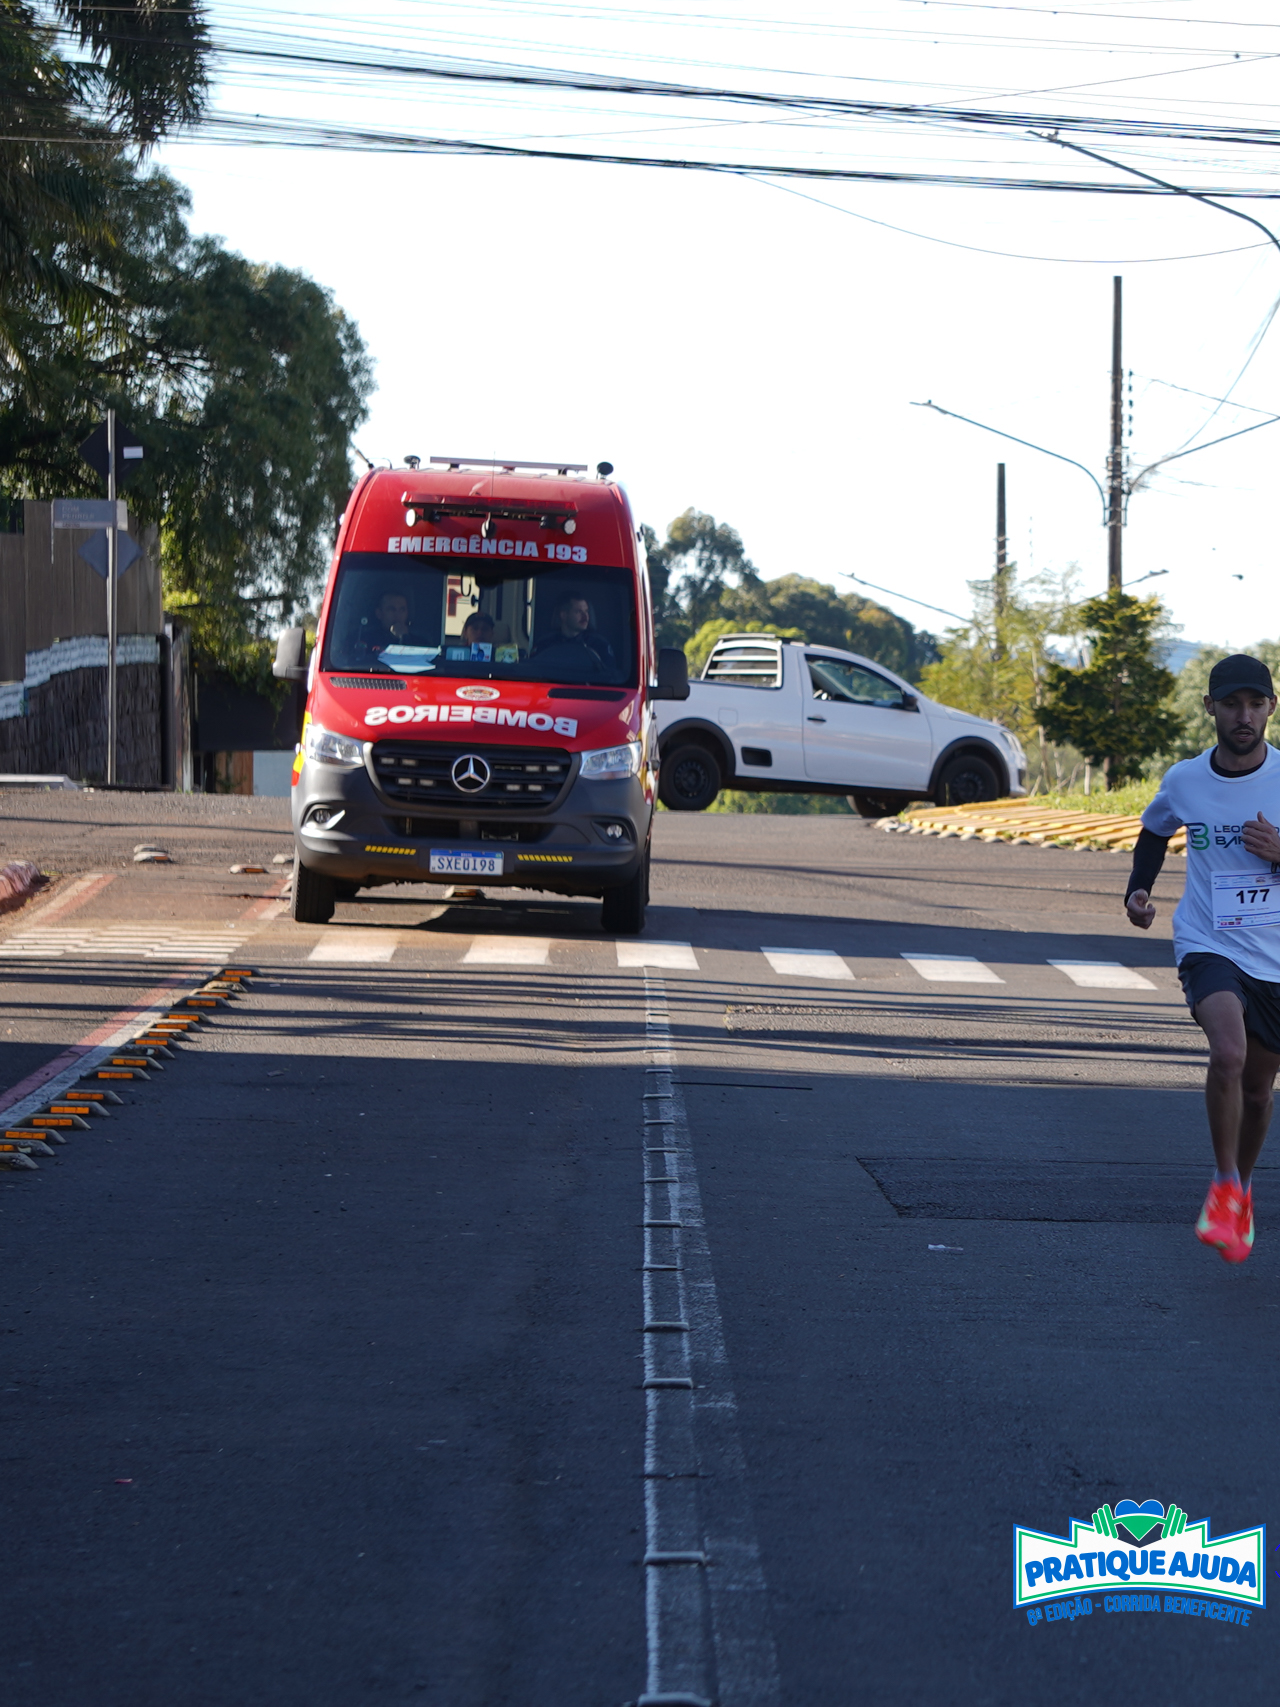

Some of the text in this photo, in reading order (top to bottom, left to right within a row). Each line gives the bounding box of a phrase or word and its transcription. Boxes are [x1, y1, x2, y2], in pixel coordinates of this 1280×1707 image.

[387, 534, 588, 563] EMERGÊNCIA 193
[1236, 888, 1270, 904] 177
